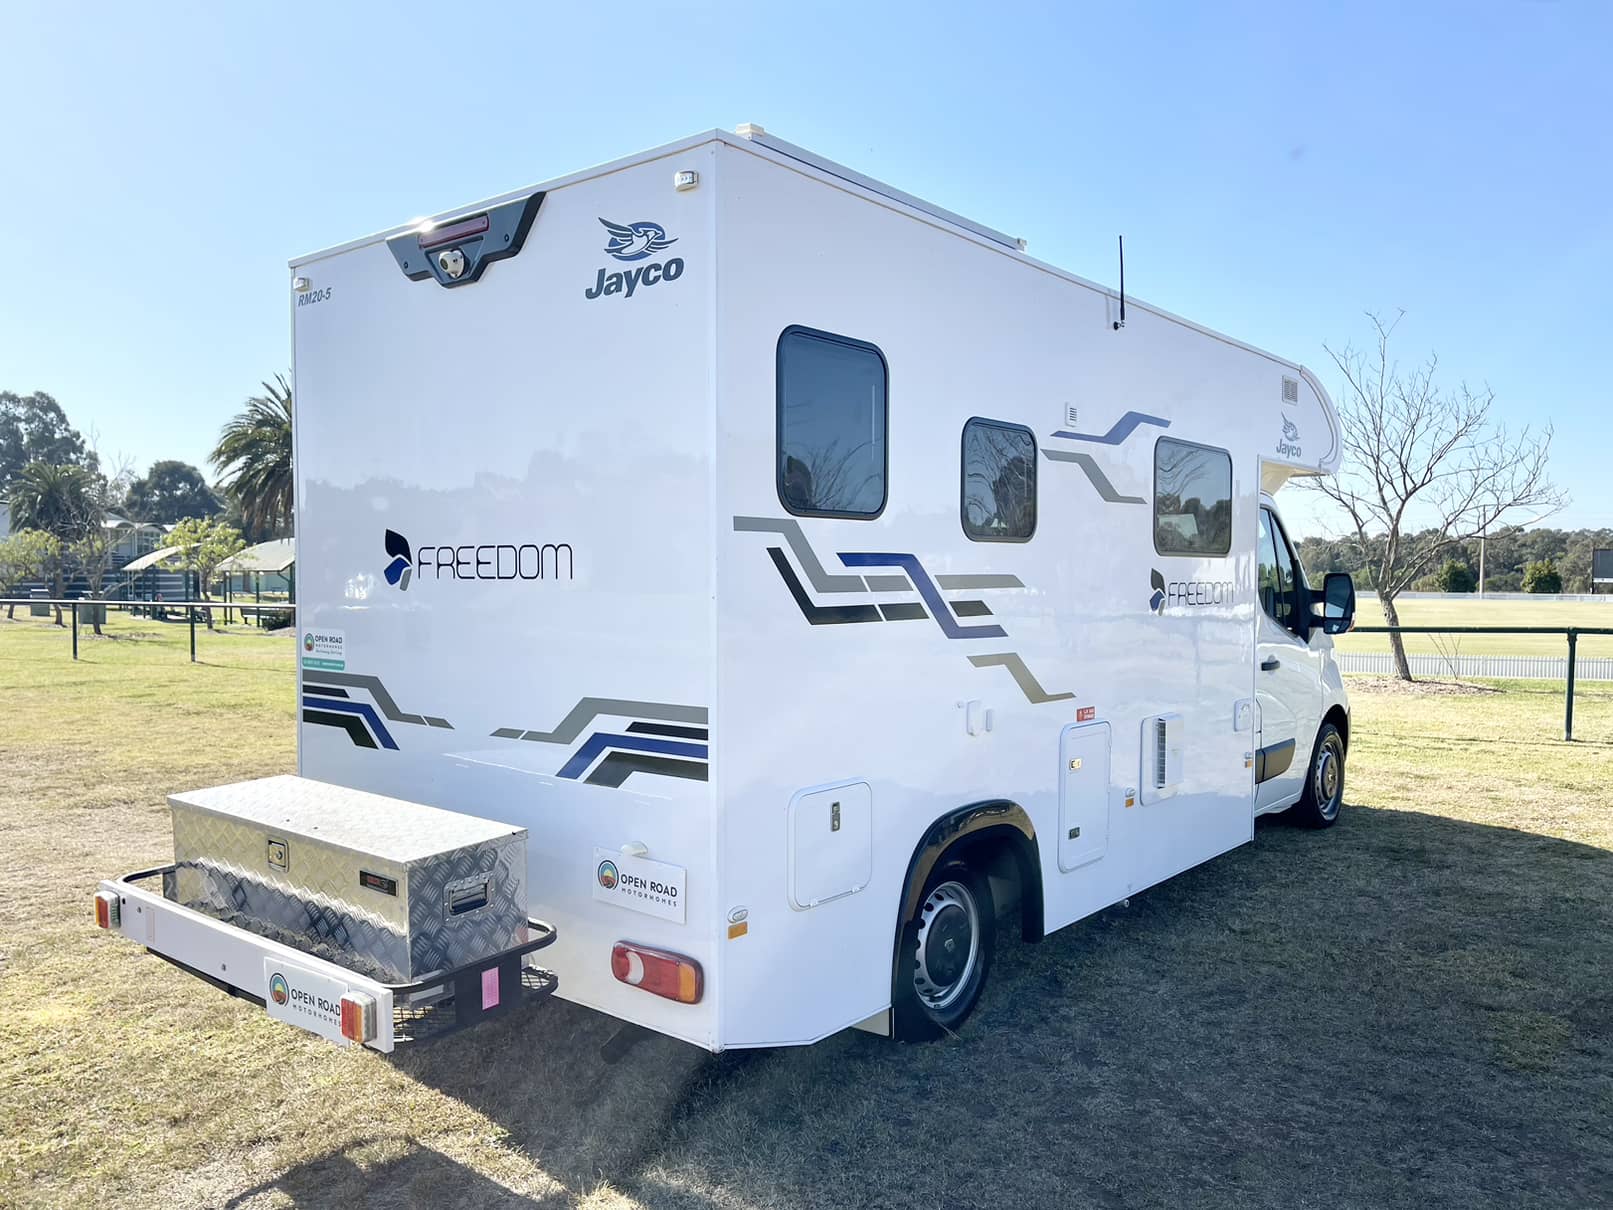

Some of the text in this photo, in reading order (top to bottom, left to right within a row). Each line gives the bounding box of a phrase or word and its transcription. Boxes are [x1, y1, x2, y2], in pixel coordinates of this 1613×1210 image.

[585, 258, 684, 299] Jayco
[298, 287, 332, 307] RM20-5
[1276, 438, 1302, 459] Jayco
[418, 543, 573, 579] FREEDOM
[1168, 582, 1234, 606] FREEDOM
[315, 635, 343, 644] OPEN ROAD
[620, 873, 678, 897] OPEN ROAD
[621, 888, 677, 907] MOTORHOMES
[291, 988, 341, 1017] OPEN ROAD
